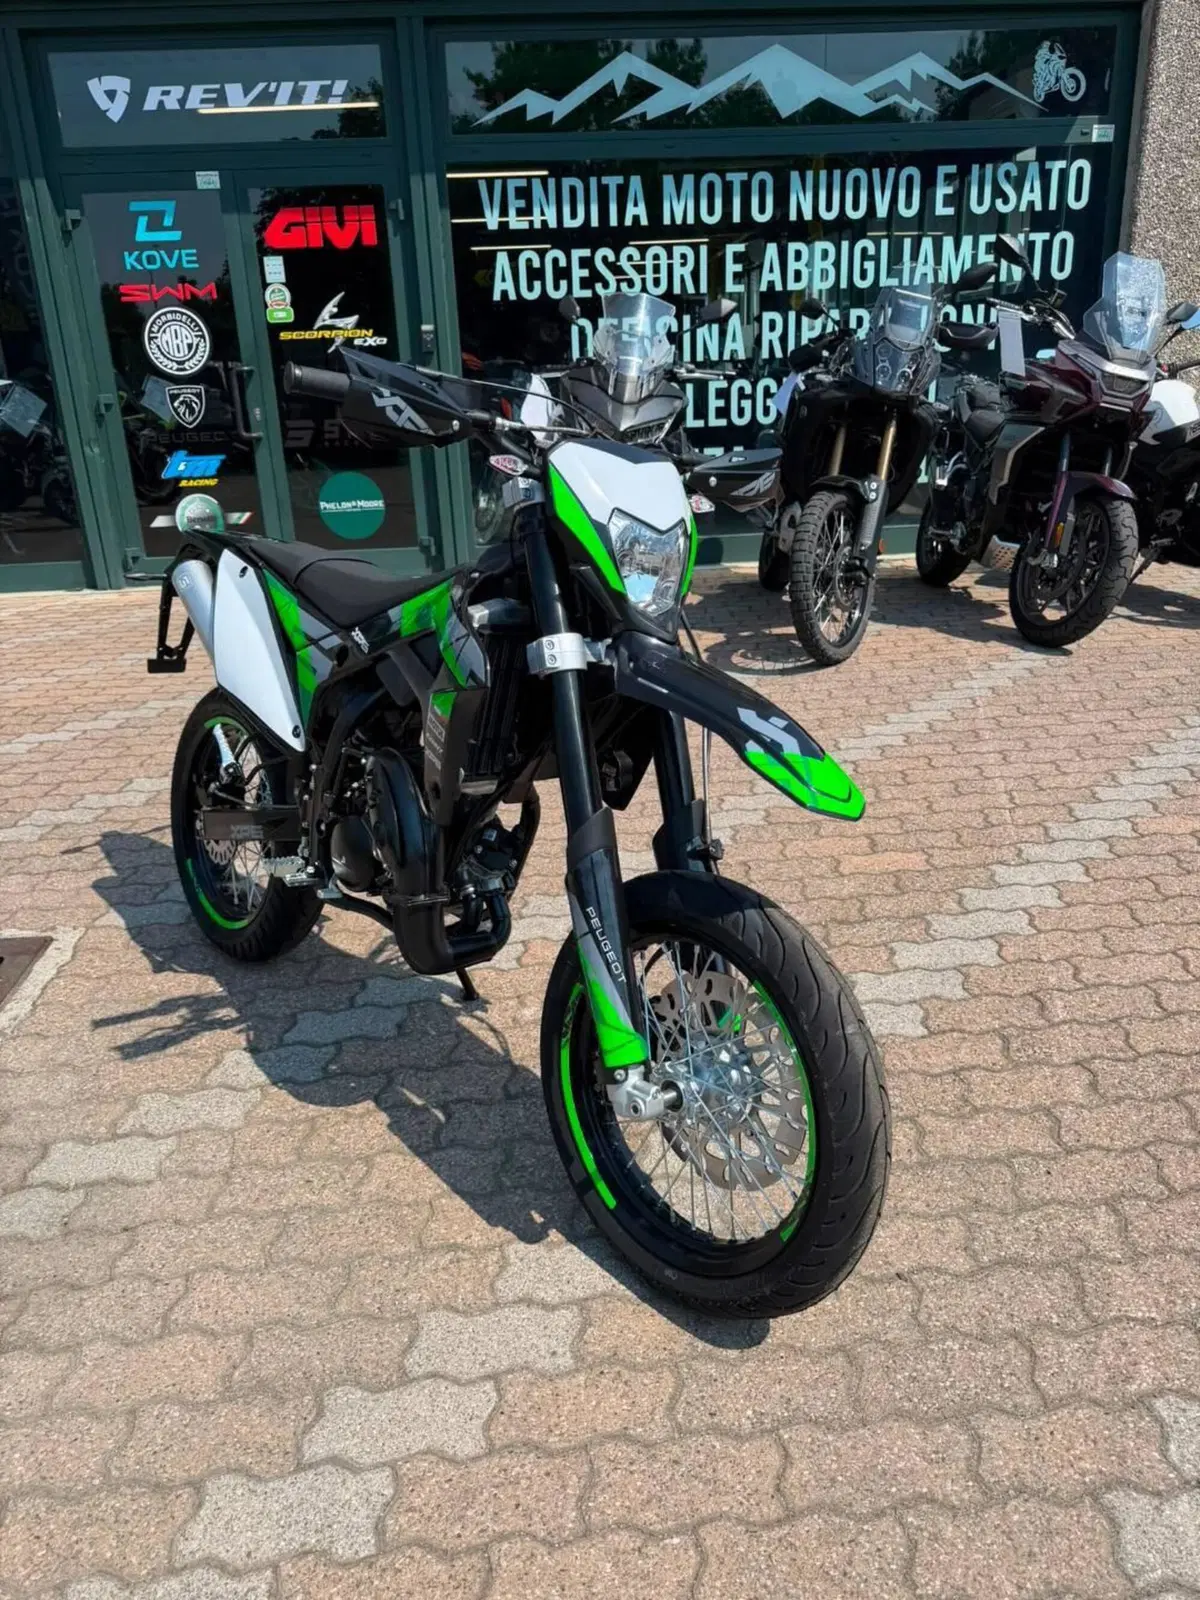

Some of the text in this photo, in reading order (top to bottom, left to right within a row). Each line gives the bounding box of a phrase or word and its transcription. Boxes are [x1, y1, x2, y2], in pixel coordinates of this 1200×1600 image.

[142, 79, 349, 111] REV'IT!
[477, 158, 1092, 231] VENDITA MOTO NUOVO E USATO
[263, 204, 378, 250] GIVI
[123, 248, 200, 271] KOVE
[493, 230, 1075, 302] ACCESSORI E ABBIGLIAMENTO
[119, 281, 218, 303] SWM
[150, 311, 200, 333] MORBIDELLI
[279, 328, 375, 341] SCORPION
[161, 324, 194, 358] MBP
[178, 478, 220, 488] RACING
[585, 906, 627, 983] PEUGEOT
